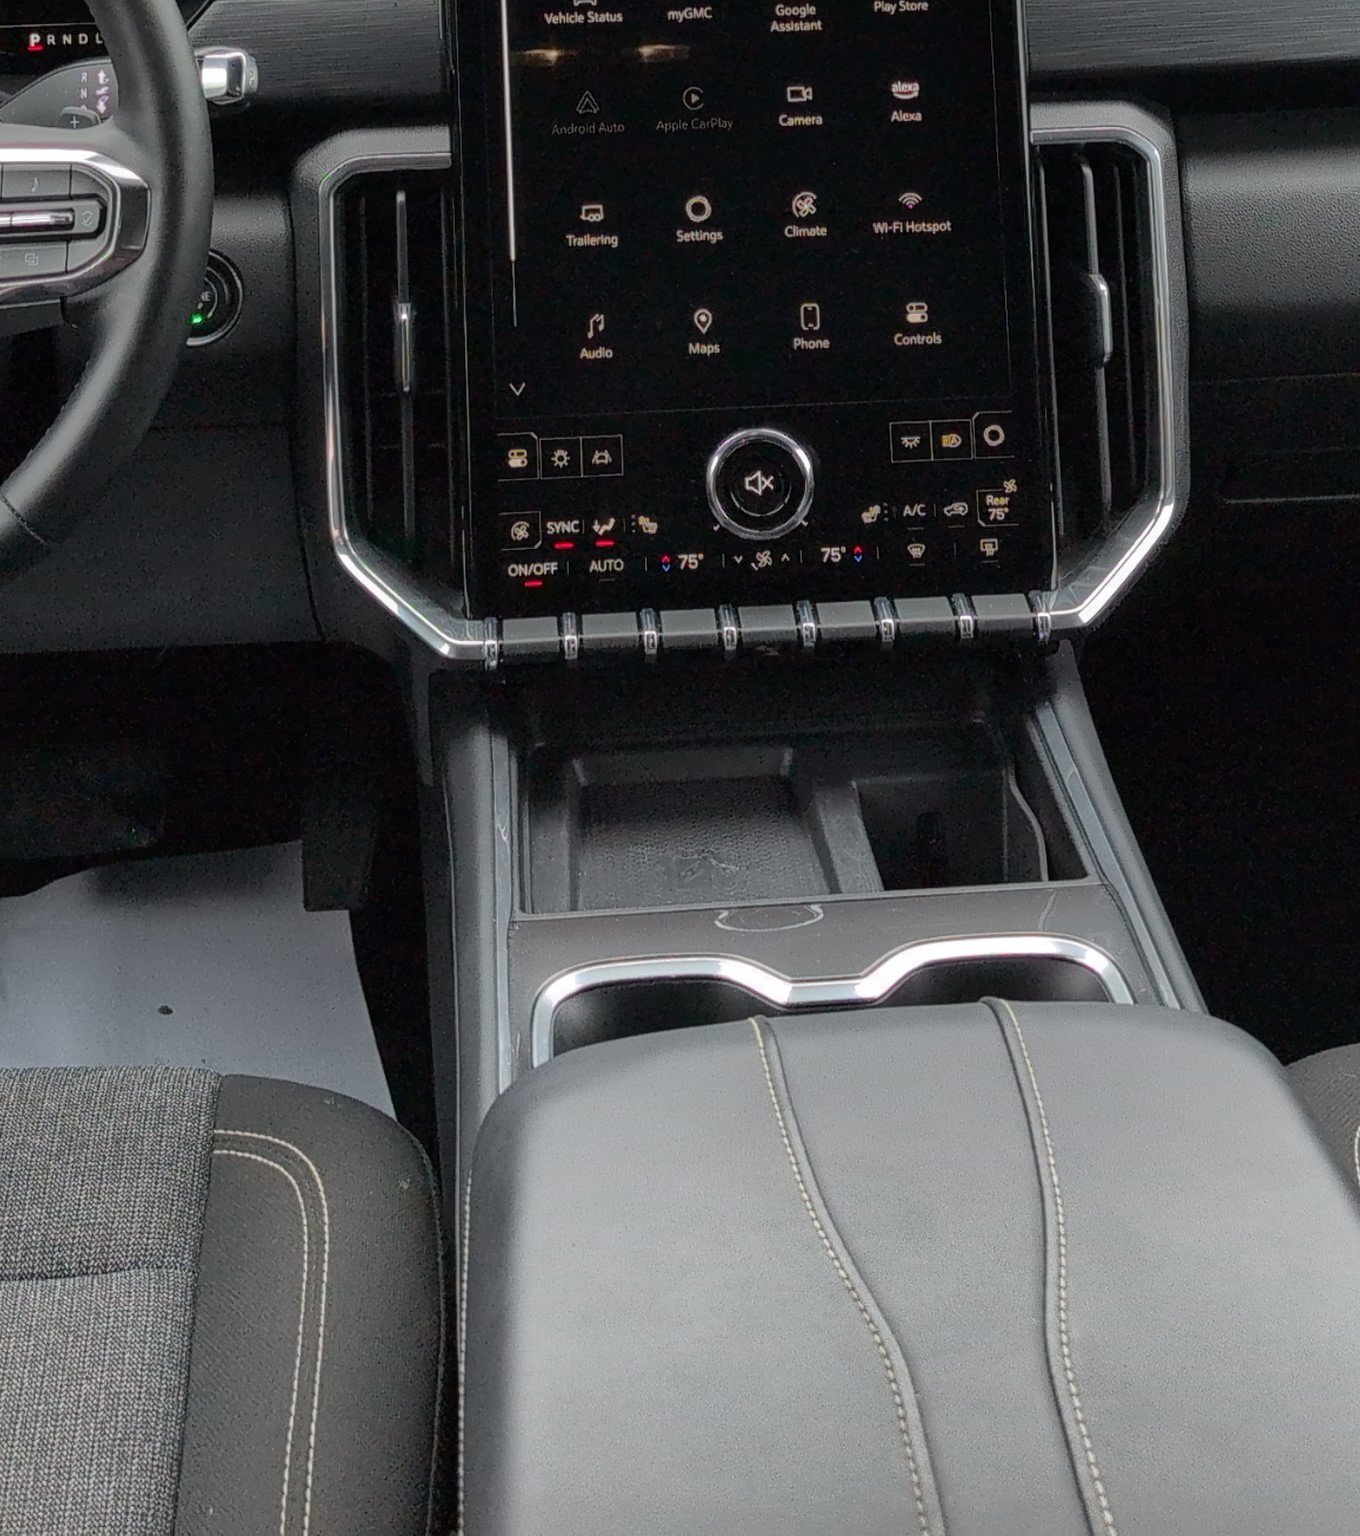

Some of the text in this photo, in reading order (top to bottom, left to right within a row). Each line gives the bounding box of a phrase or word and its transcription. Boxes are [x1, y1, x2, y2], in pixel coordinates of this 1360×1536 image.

[666, 6, 713, 23] myGMC
[775, 4, 817, 19] Google
[873, 0, 929, 15] Play Store
[544, 10, 624, 24] Vehicle Status
[770, 19, 823, 31] Assistant
[31, 34, 40, 45] P
[48, 34, 56, 44] R
[63, 34, 72, 44] N
[80, 33, 88, 44] D
[81, 72, 88, 83] R
[80, 87, 88, 99] N
[778, 113, 823, 127] Camera
[890, 109, 923, 123] Alexa
[551, 121, 625, 136] Android Auto
[656, 116, 734, 134] Apple CarPlay
[784, 224, 828, 238] Climate
[872, 219, 952, 235] Wi-Fi Hotspot
[565, 233, 619, 249] Trailering
[676, 229, 724, 244] Settings
[792, 336, 831, 350] Phone
[893, 331, 943, 346] Controls
[579, 346, 614, 360] Audio
[688, 341, 721, 357] Maps
[985, 495, 1010, 506] Rear
[902, 503, 927, 518] A/C
[546, 519, 580, 535] SYNC
[507, 561, 559, 577] ON/OFF
[589, 558, 625, 573] AUTO
